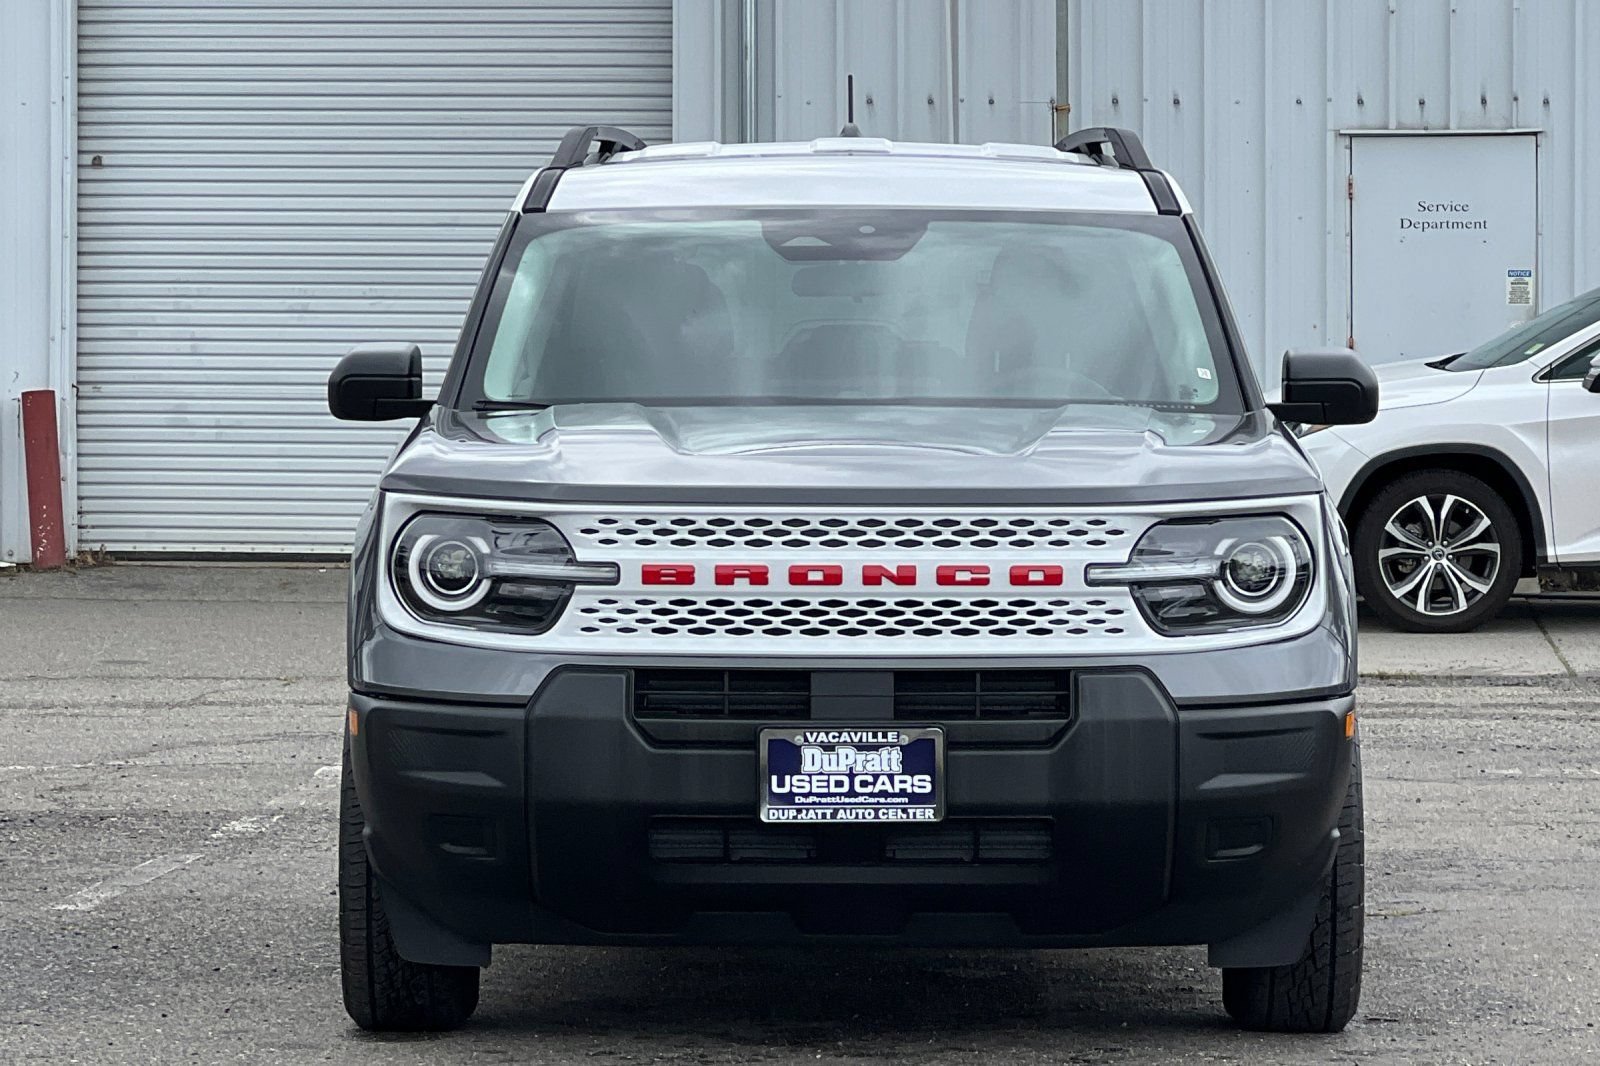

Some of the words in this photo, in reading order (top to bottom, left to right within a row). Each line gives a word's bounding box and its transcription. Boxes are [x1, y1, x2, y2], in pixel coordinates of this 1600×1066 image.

[1417, 201, 1470, 213] Service
[1400, 218, 1488, 232] Department
[641, 564, 1064, 587] BRONCO
[806, 732, 898, 743] VACAVILLE
[801, 746, 902, 773] DuPratt
[771, 775, 849, 793] USED
[854, 775, 932, 793] CARS
[836, 809, 875, 820] AUTO
[878, 809, 935, 820] CENTER
